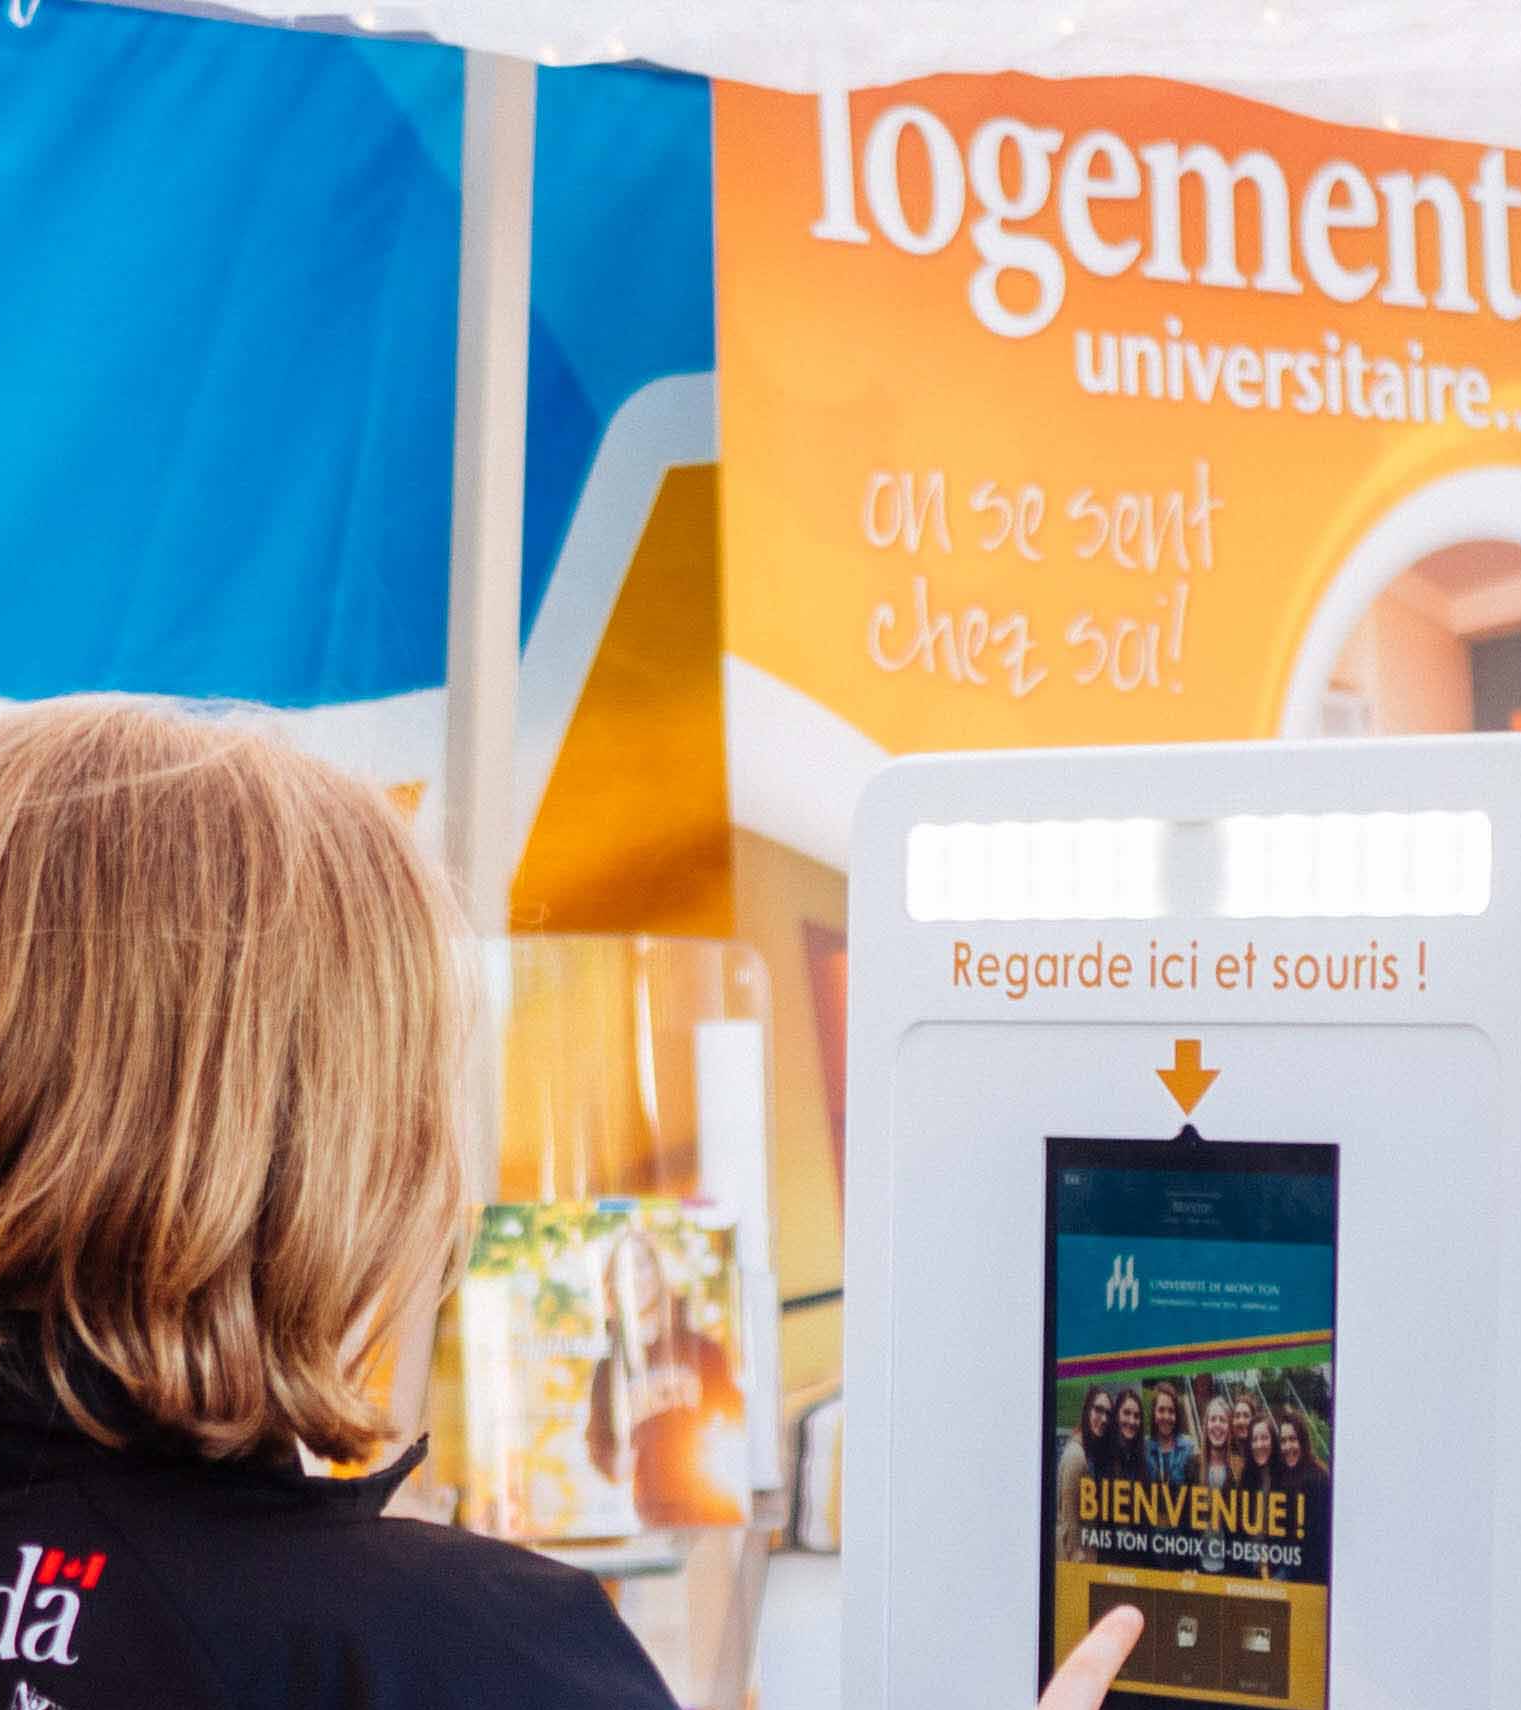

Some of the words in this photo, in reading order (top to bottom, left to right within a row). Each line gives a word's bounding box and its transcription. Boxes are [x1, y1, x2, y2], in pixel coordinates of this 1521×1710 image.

[861, 466, 953, 555] on
[968, 476, 1046, 566] se
[1065, 457, 1225, 573] sent
[867, 574, 1048, 699] chez
[1064, 581, 1190, 696] soi!
[953, 941, 1133, 1000] Regarde
[1149, 940, 1199, 990] ici
[1215, 941, 1257, 990] et
[1272, 940, 1399, 991] souris
[1080, 1476, 1287, 1538] BIENVENUE
[1081, 1527, 1112, 1549] FAIS
[1116, 1531, 1147, 1551] TON
[1152, 1535, 1202, 1557] CHOIX
[1208, 1539, 1302, 1566] CI-DESSOUS
